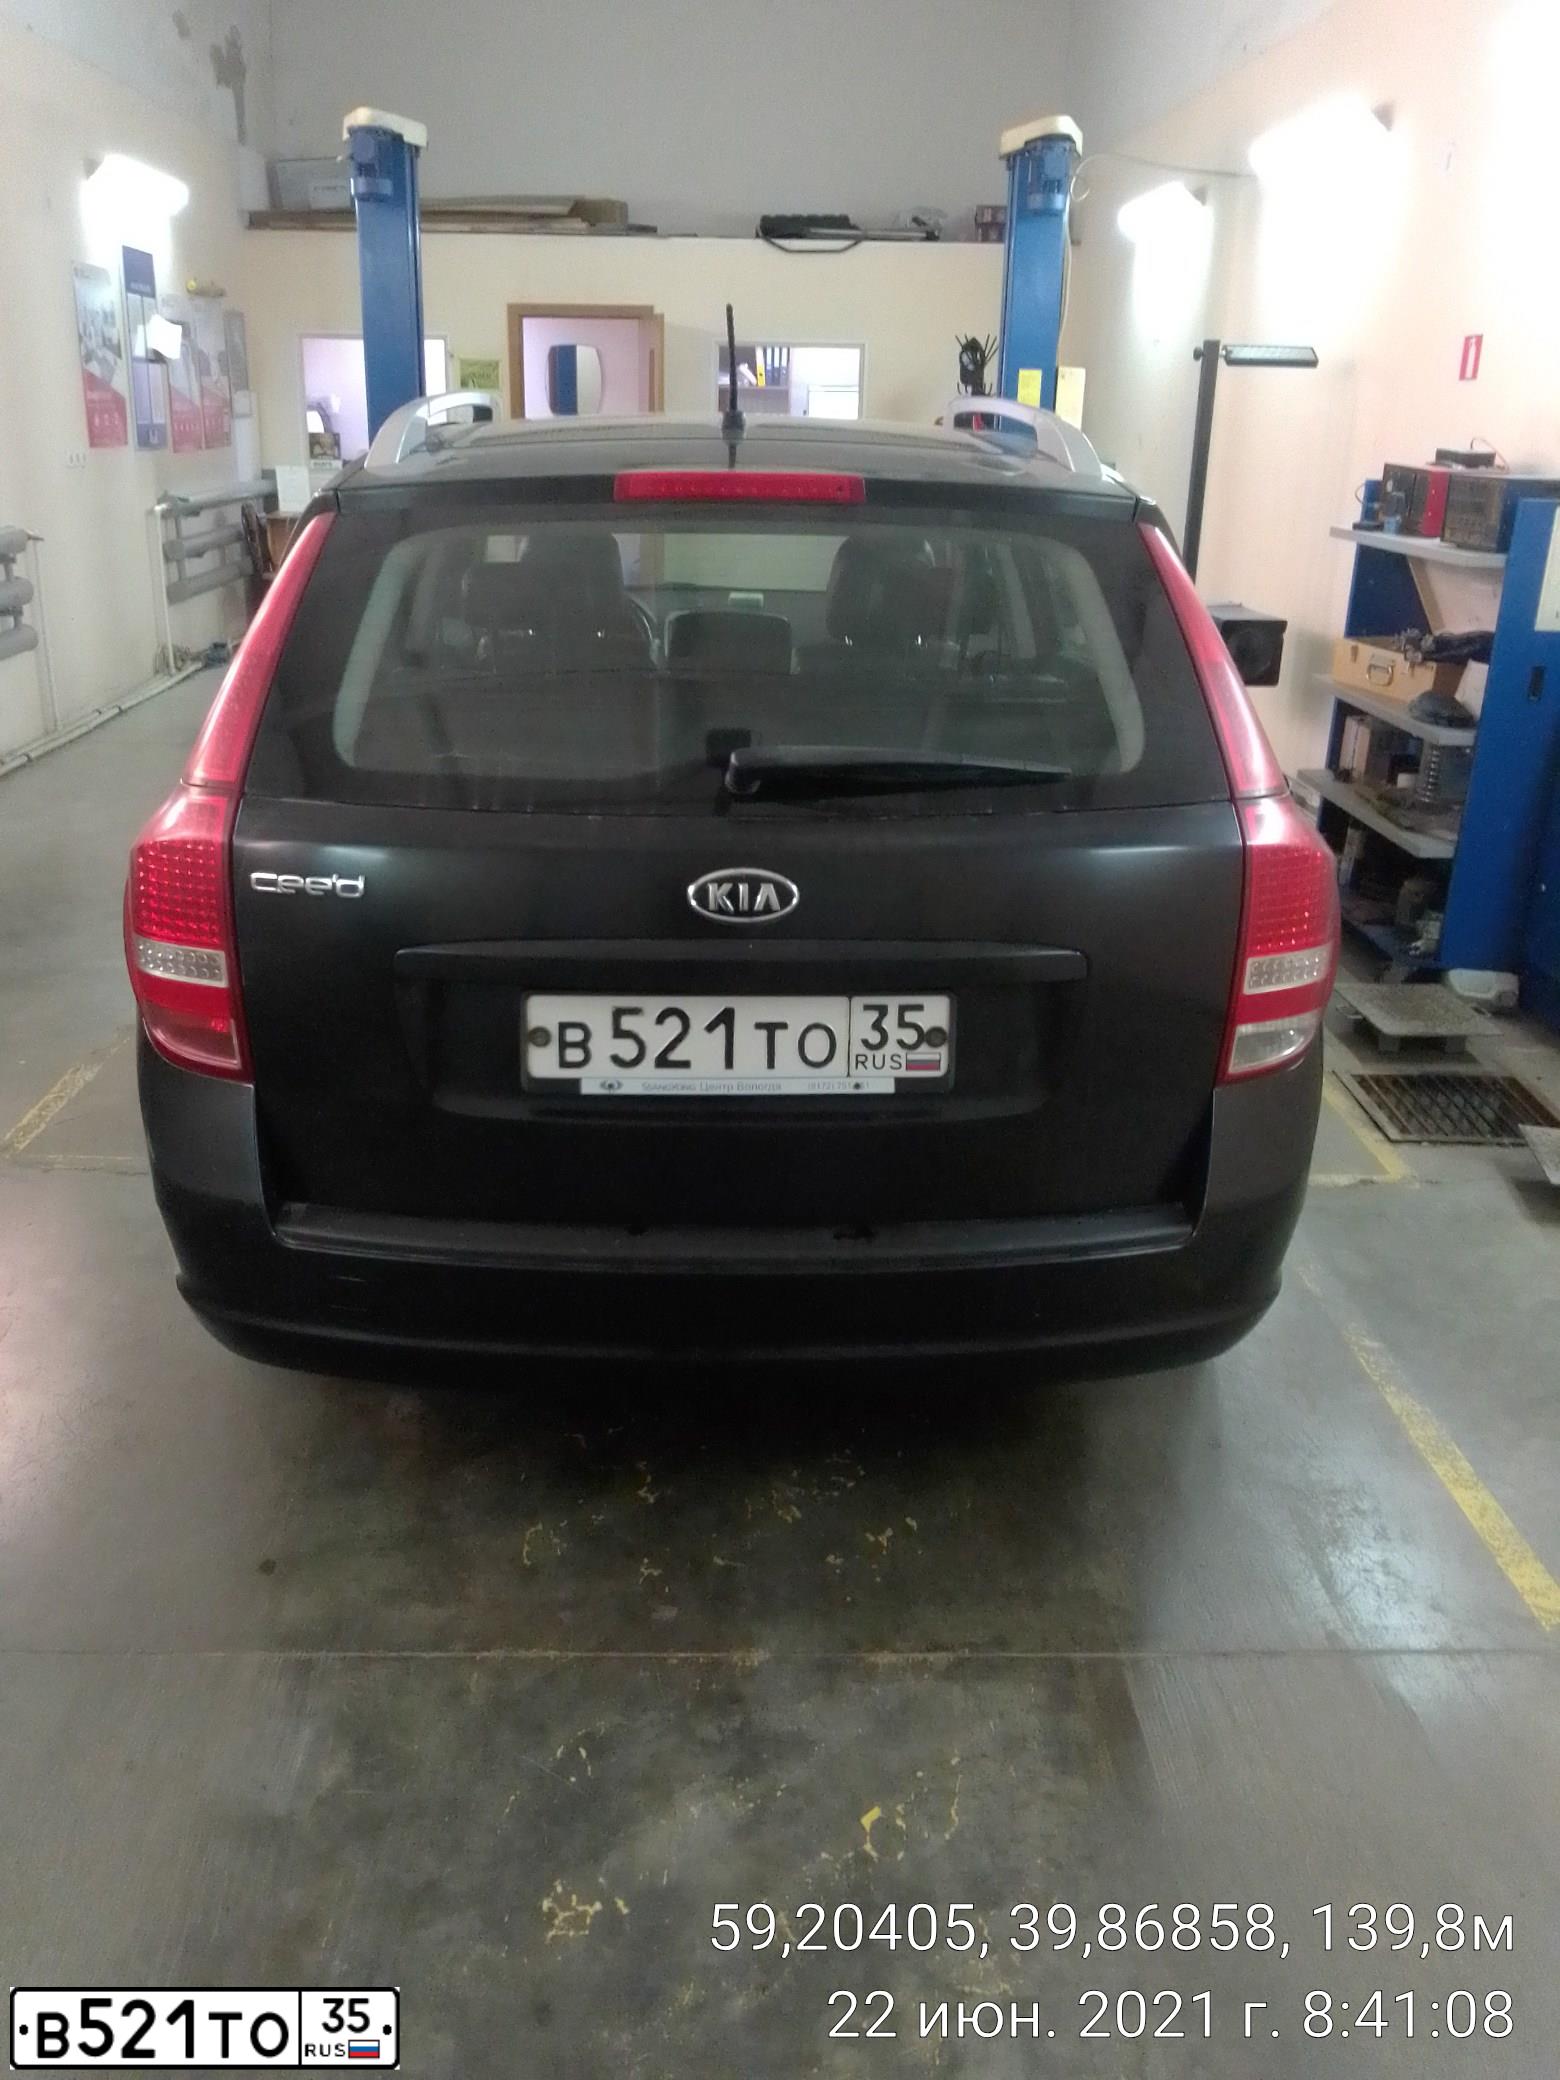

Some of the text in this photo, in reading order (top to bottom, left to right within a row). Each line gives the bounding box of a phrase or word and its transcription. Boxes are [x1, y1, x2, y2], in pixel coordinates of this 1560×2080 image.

[707, 882, 781, 914] KIA
[860, 1004, 925, 1051] 35
[855, 1053, 903, 1070] RUS
